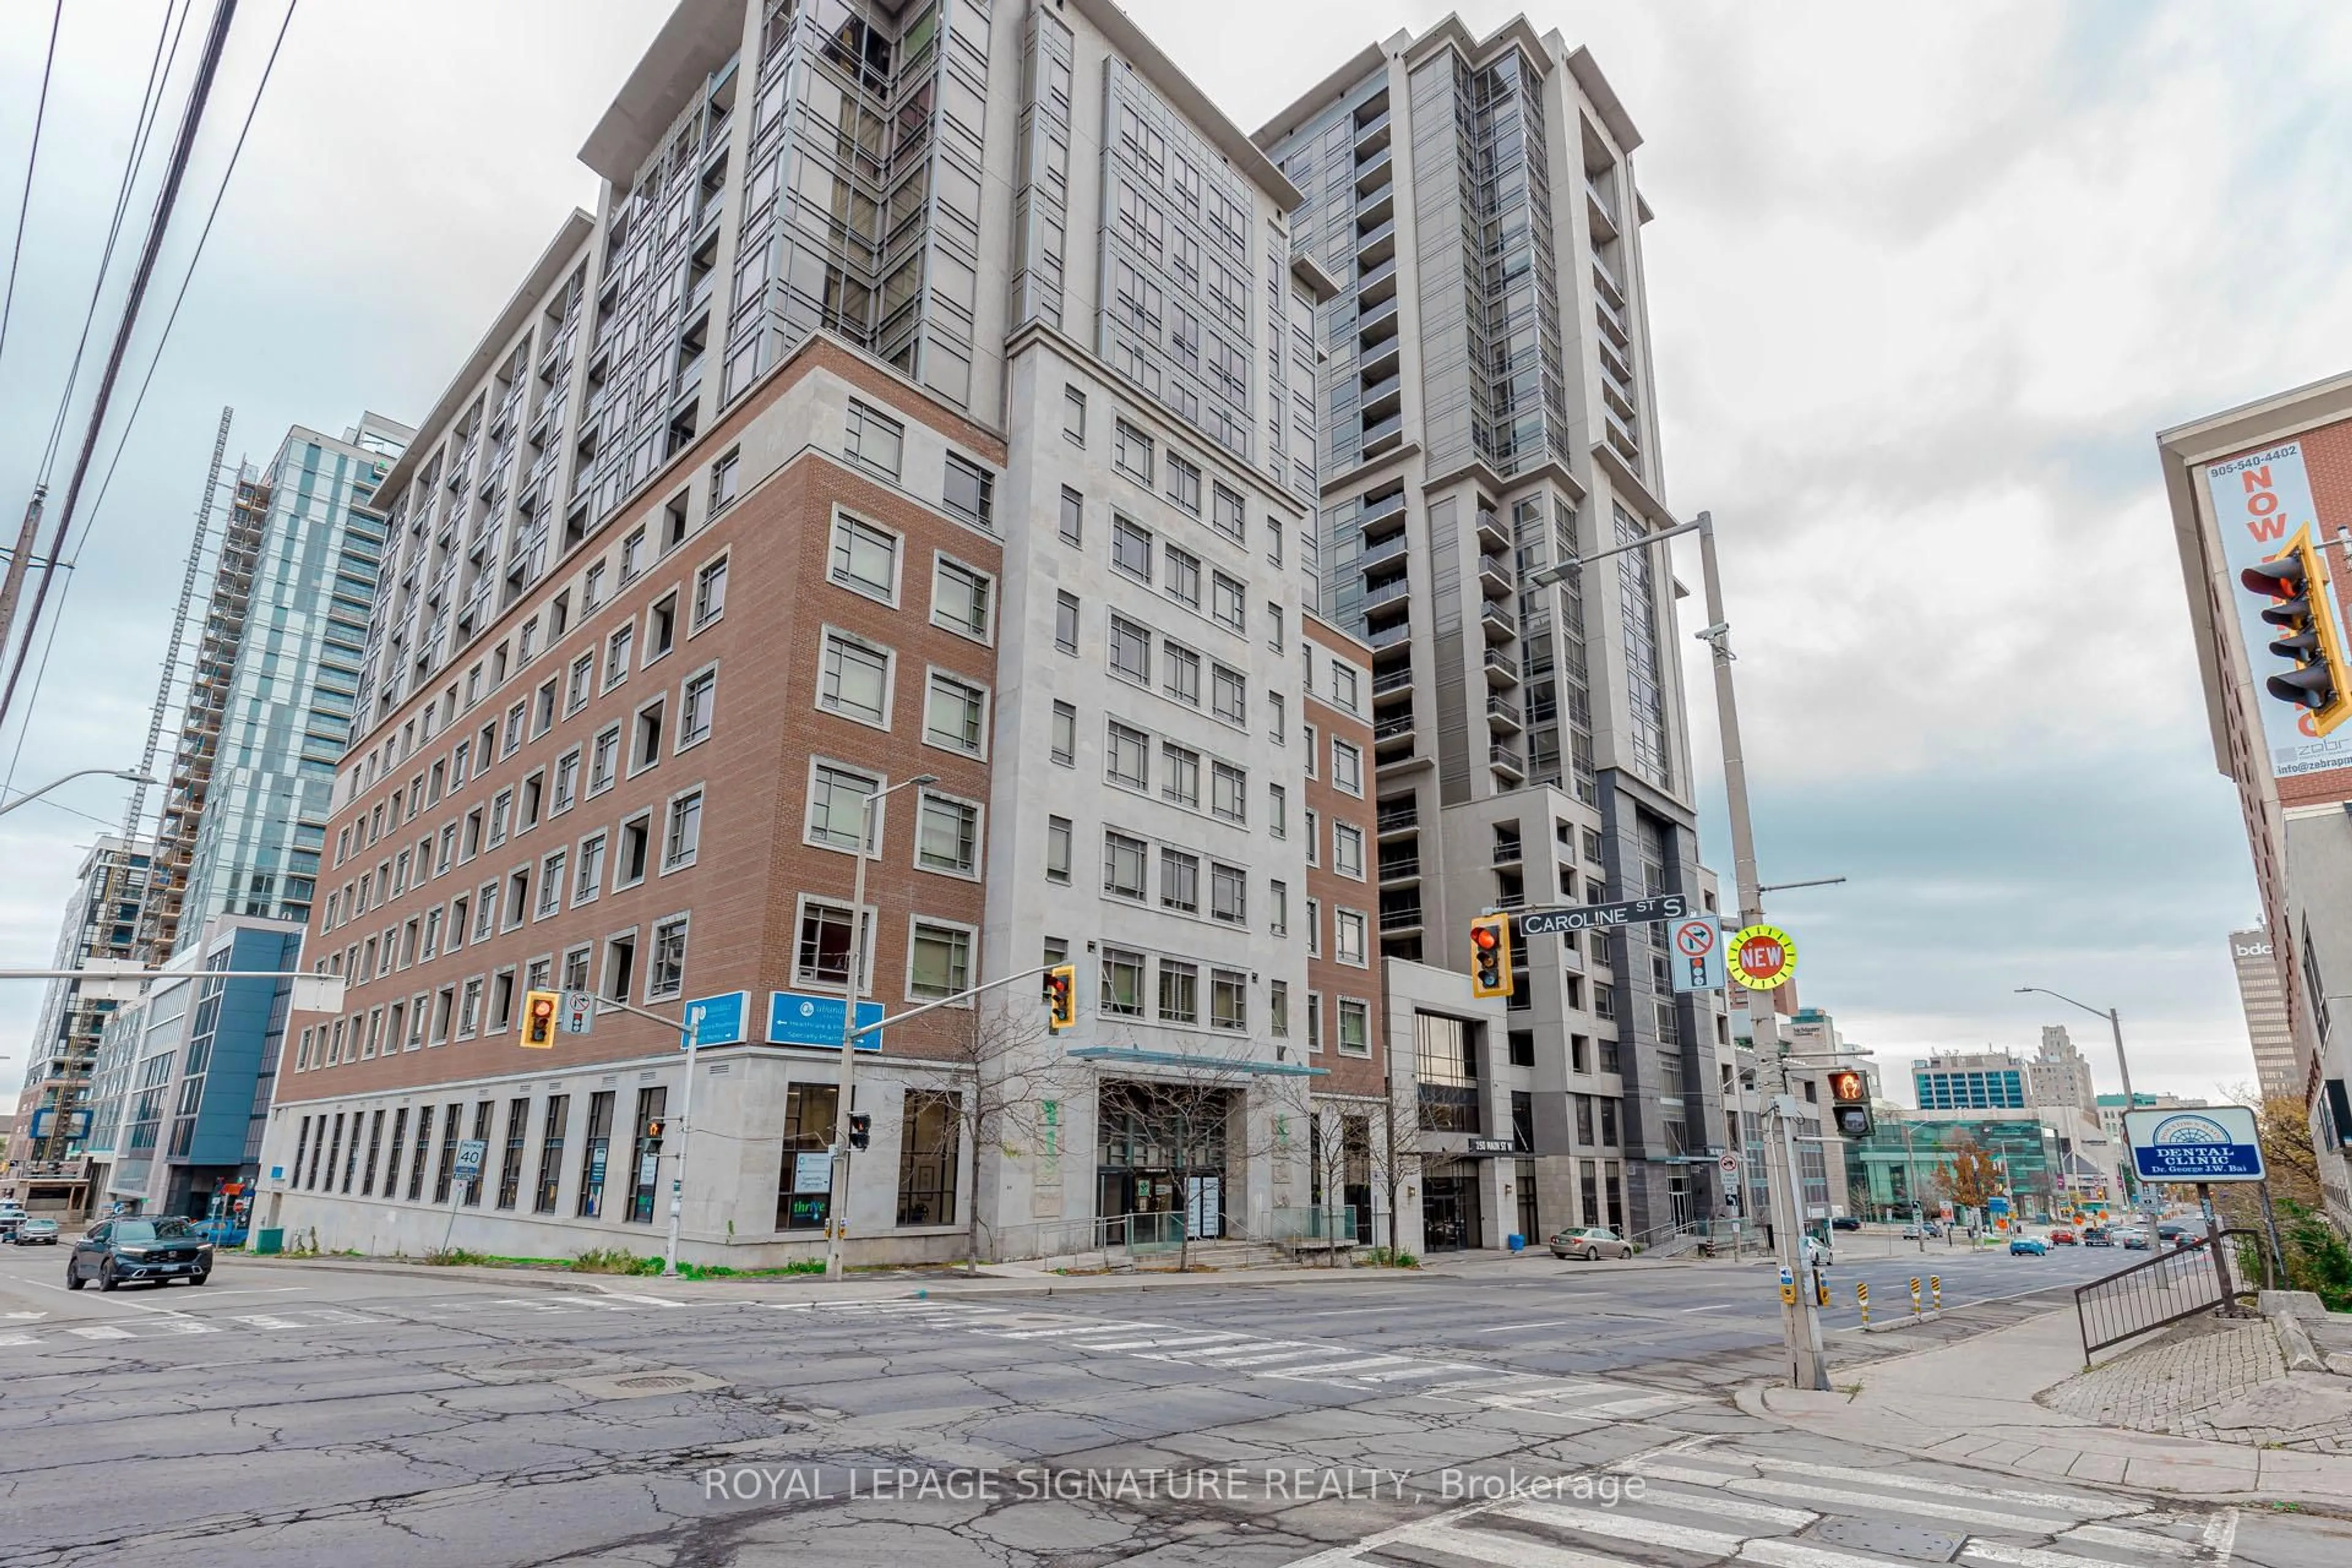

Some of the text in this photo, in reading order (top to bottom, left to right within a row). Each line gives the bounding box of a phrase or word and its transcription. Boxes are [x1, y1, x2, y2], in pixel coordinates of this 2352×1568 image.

[2211, 445, 2297, 478] 905-540-4402
[2241, 465, 2287, 543] NOW
[1525, 899, 1682, 933] CAROLINE ST S
[1741, 946, 1782, 968] NEW
[2236, 943, 2273, 956] bdc
[461, 1152, 478, 1163] 40
[2156, 1147, 2234, 1157] DENTAL
[2165, 1156, 2230, 1165] CLINIC
